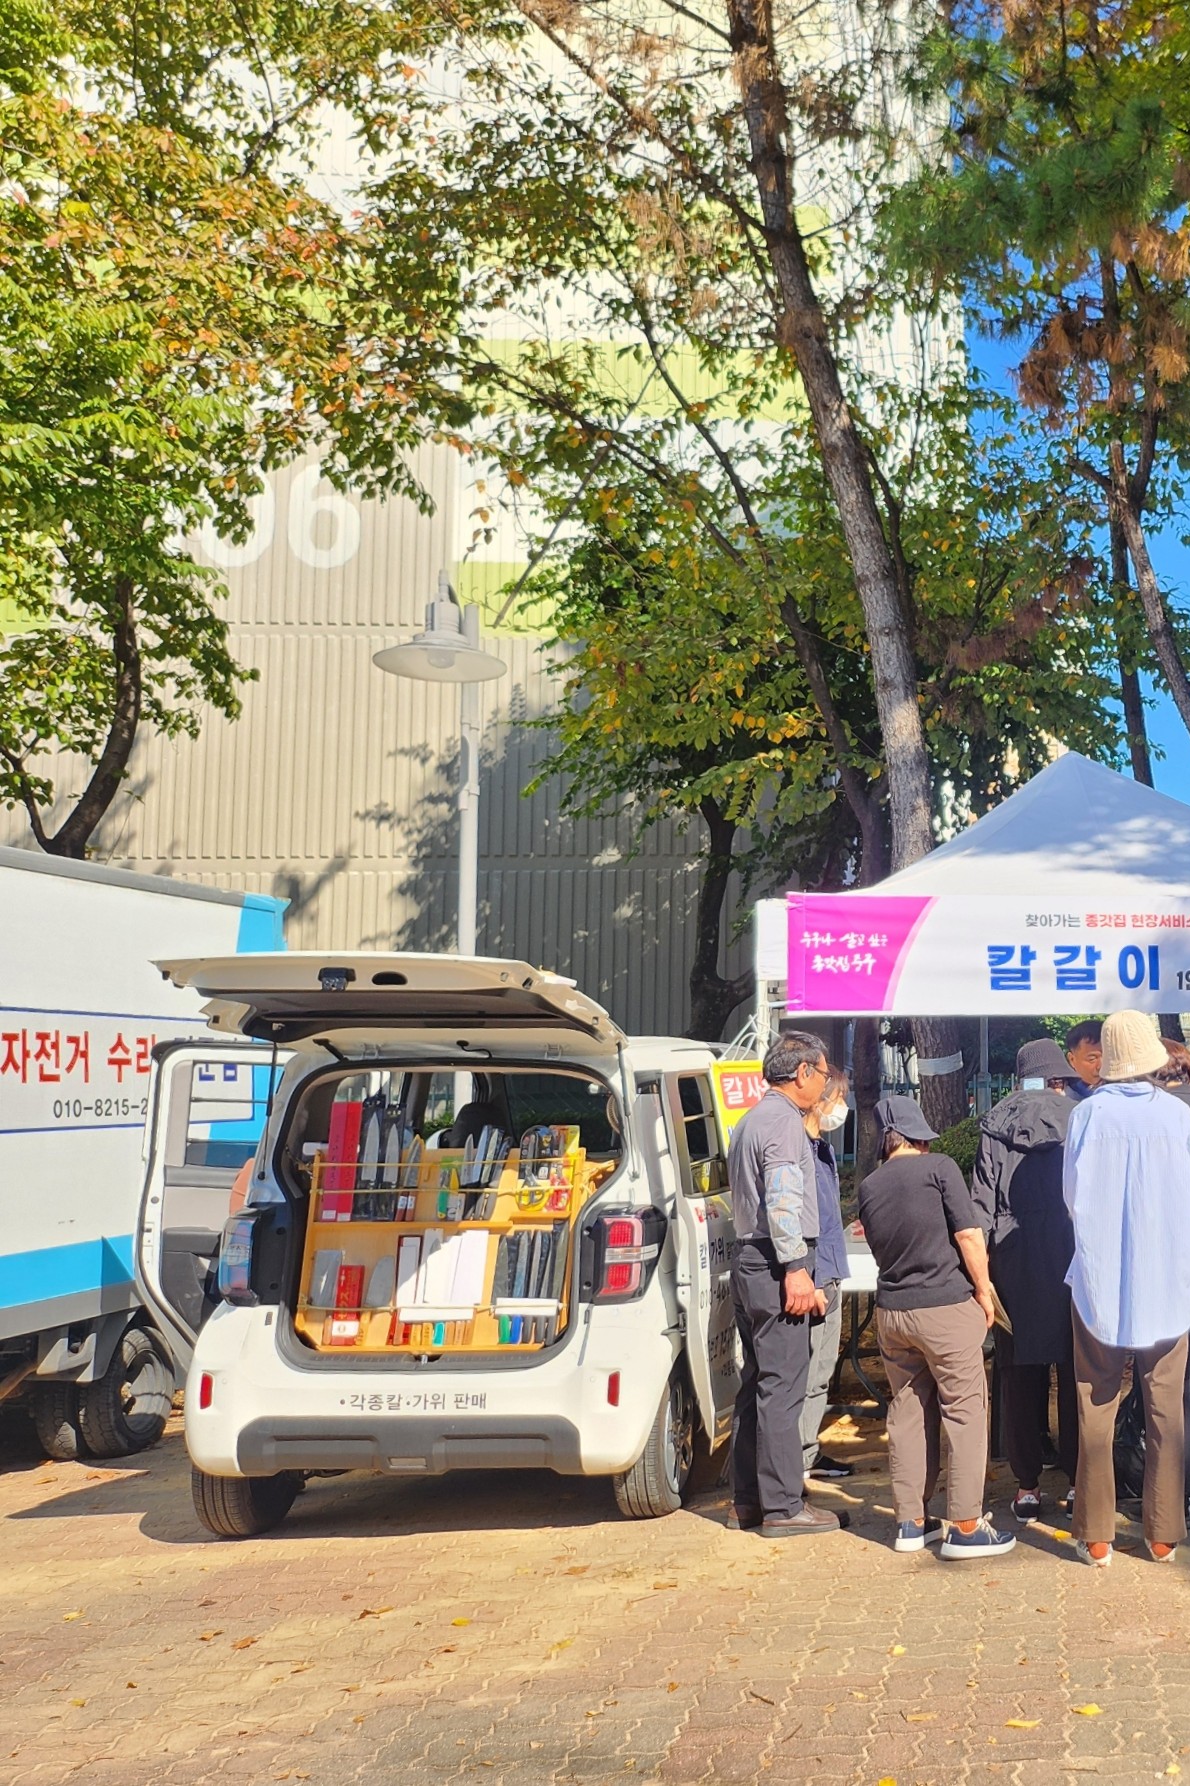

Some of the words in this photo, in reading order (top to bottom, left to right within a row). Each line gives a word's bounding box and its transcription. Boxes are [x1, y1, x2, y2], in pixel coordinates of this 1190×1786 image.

[1025, 914, 1081, 928] 찾아가는
[1085, 914, 1126, 928] 종갓집
[1, 1028, 89, 1084] 자전거
[453, 1392, 487, 1410] 판매
